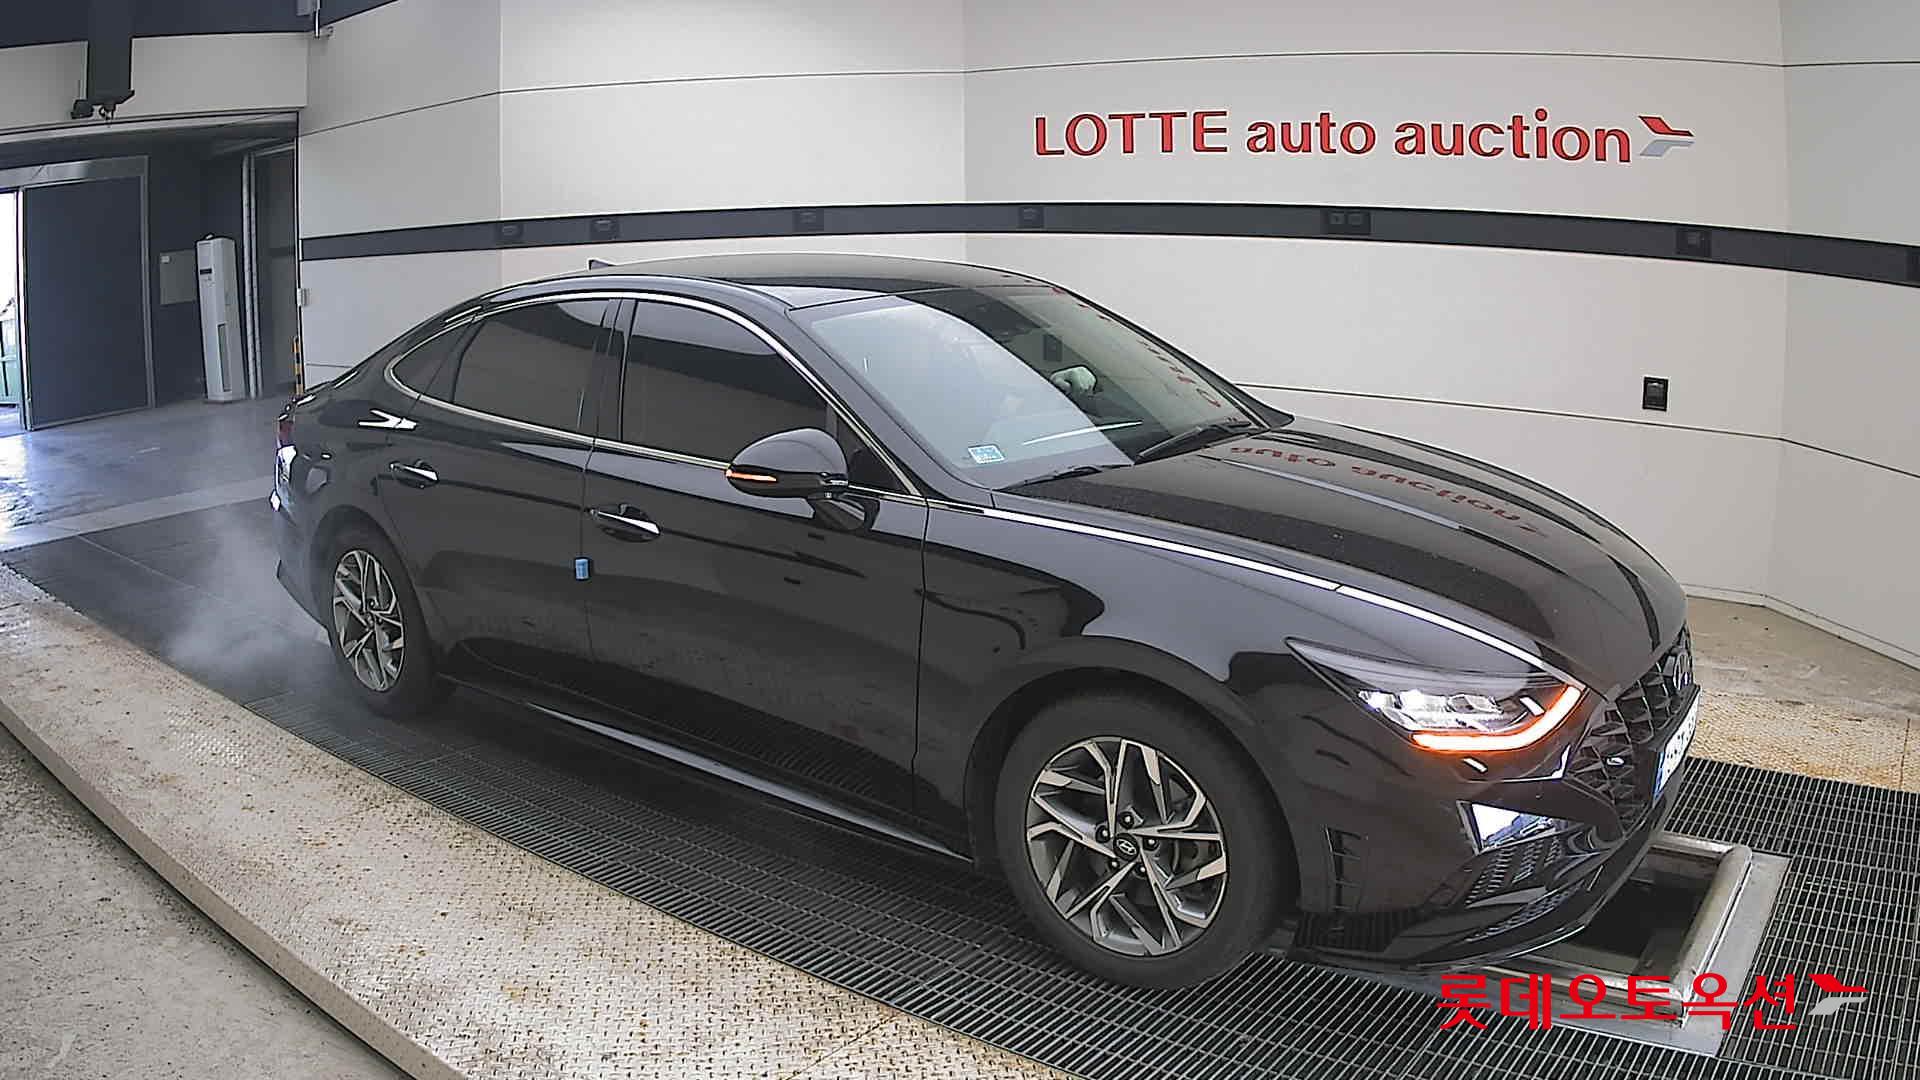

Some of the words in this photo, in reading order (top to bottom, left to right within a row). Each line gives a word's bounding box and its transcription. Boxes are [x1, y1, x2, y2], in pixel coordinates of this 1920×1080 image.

[1035, 112, 1228, 156] LOTTE
[1246, 112, 1376, 155] auto
[1394, 108, 1631, 163] auction
